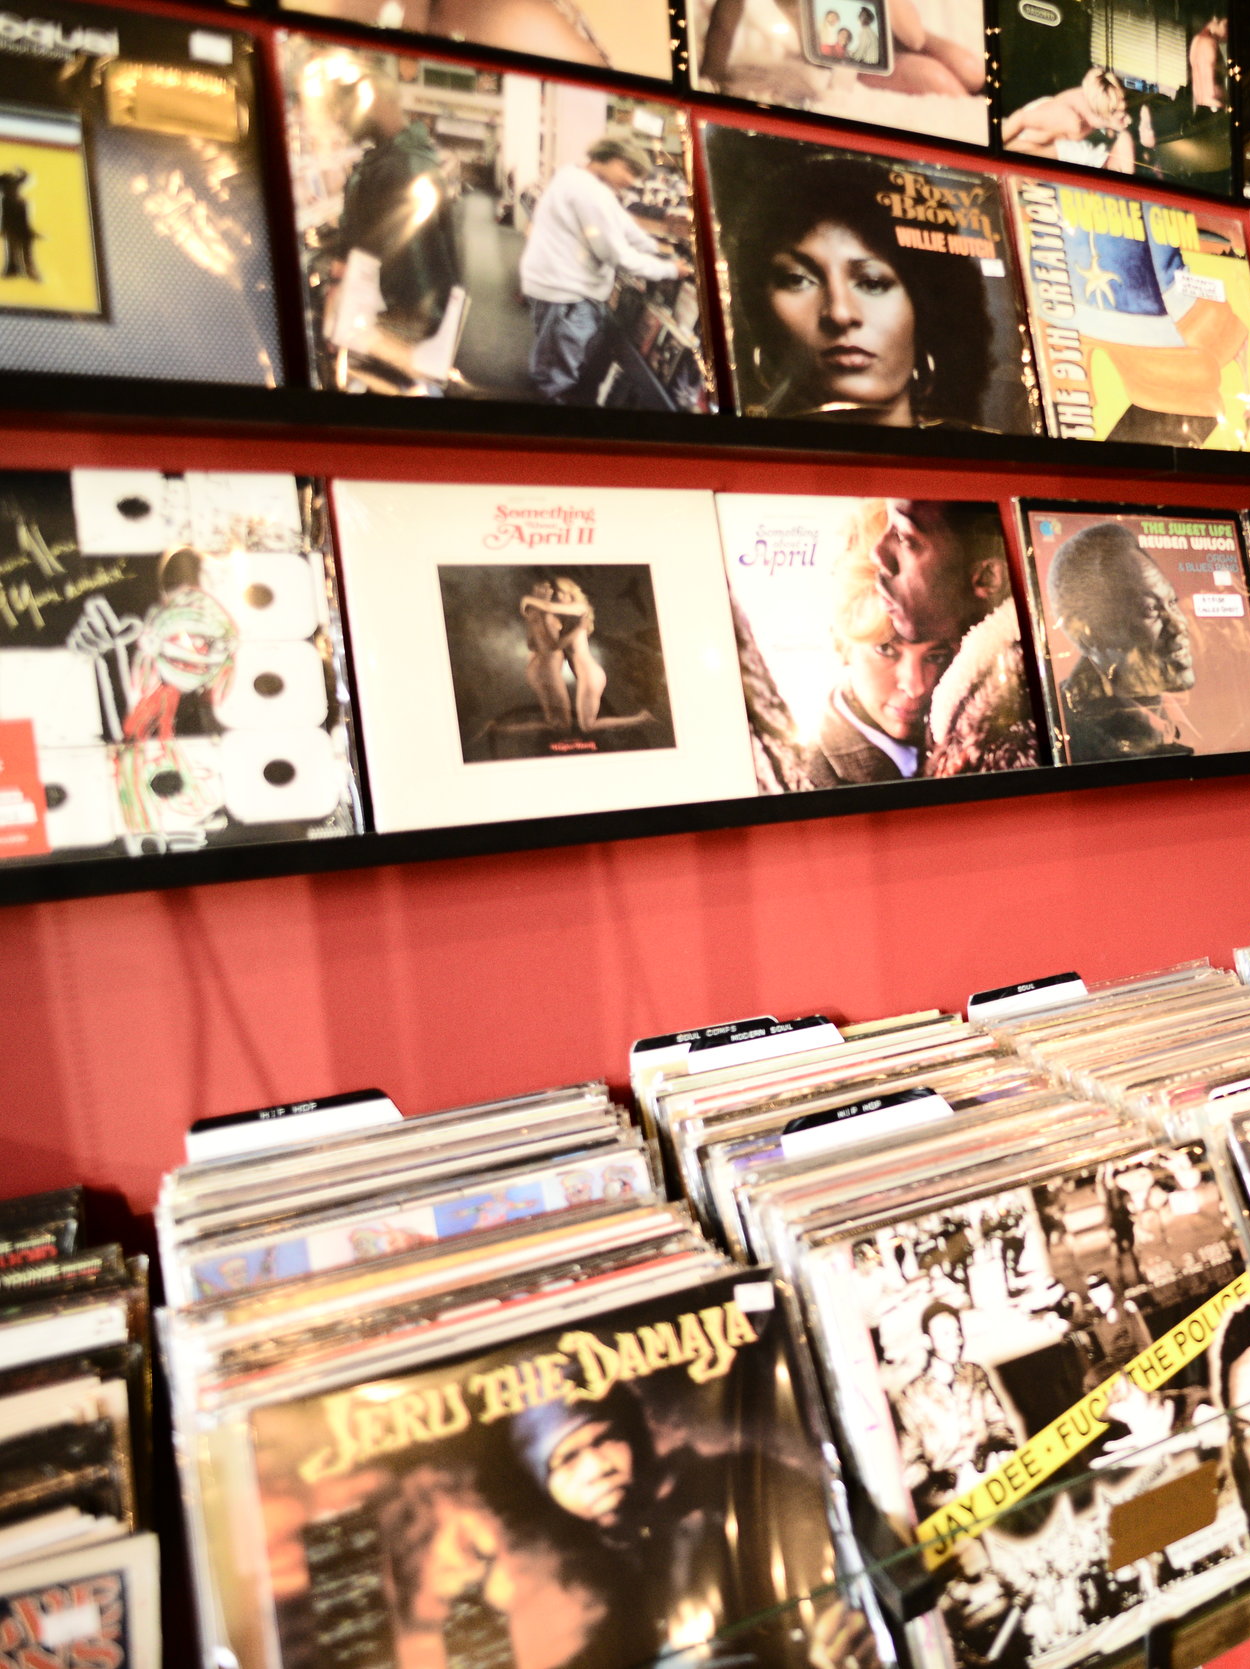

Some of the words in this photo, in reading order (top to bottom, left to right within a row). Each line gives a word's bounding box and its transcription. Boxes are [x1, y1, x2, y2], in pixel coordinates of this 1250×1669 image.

[889, 170, 985, 207] Foxy
[876, 191, 1000, 242] Brown
[1059, 188, 1146, 241] BUBBLE
[1149, 206, 1200, 250] GUM
[895, 225, 947, 253] WILLIE
[947, 233, 996, 260] HUTCH
[1022, 180, 1076, 320] CREATION
[494, 504, 596, 525] Something
[482, 523, 571, 550] April
[577, 527, 595, 545] II
[1141, 521, 1165, 535] THE
[1168, 522, 1206, 537] SWEET
[1190, 536, 1236, 551] WILSON
[739, 539, 817, 576] April
[1017, 983, 1035, 992] SOUL
[676, 1032, 701, 1042] SOUL
[705, 1025, 737, 1037] COMPS
[730, 1029, 766, 1041] MODERN
[770, 1024, 793, 1034] SOUL
[260, 1108, 285, 1119] HIP
[292, 1102, 317, 1113] HOP
[837, 1106, 858, 1119] HIP
[299, 1380, 473, 1483] JERU
[469, 1350, 577, 1423] THE
[558, 1300, 759, 1400] DAMAJA
[929, 1498, 980, 1555] JAY
[986, 1448, 1043, 1507] DEE
[1057, 1390, 1116, 1452] FUC
[1125, 1345, 1174, 1387] THE
[1173, 1282, 1247, 1357] POLICE
